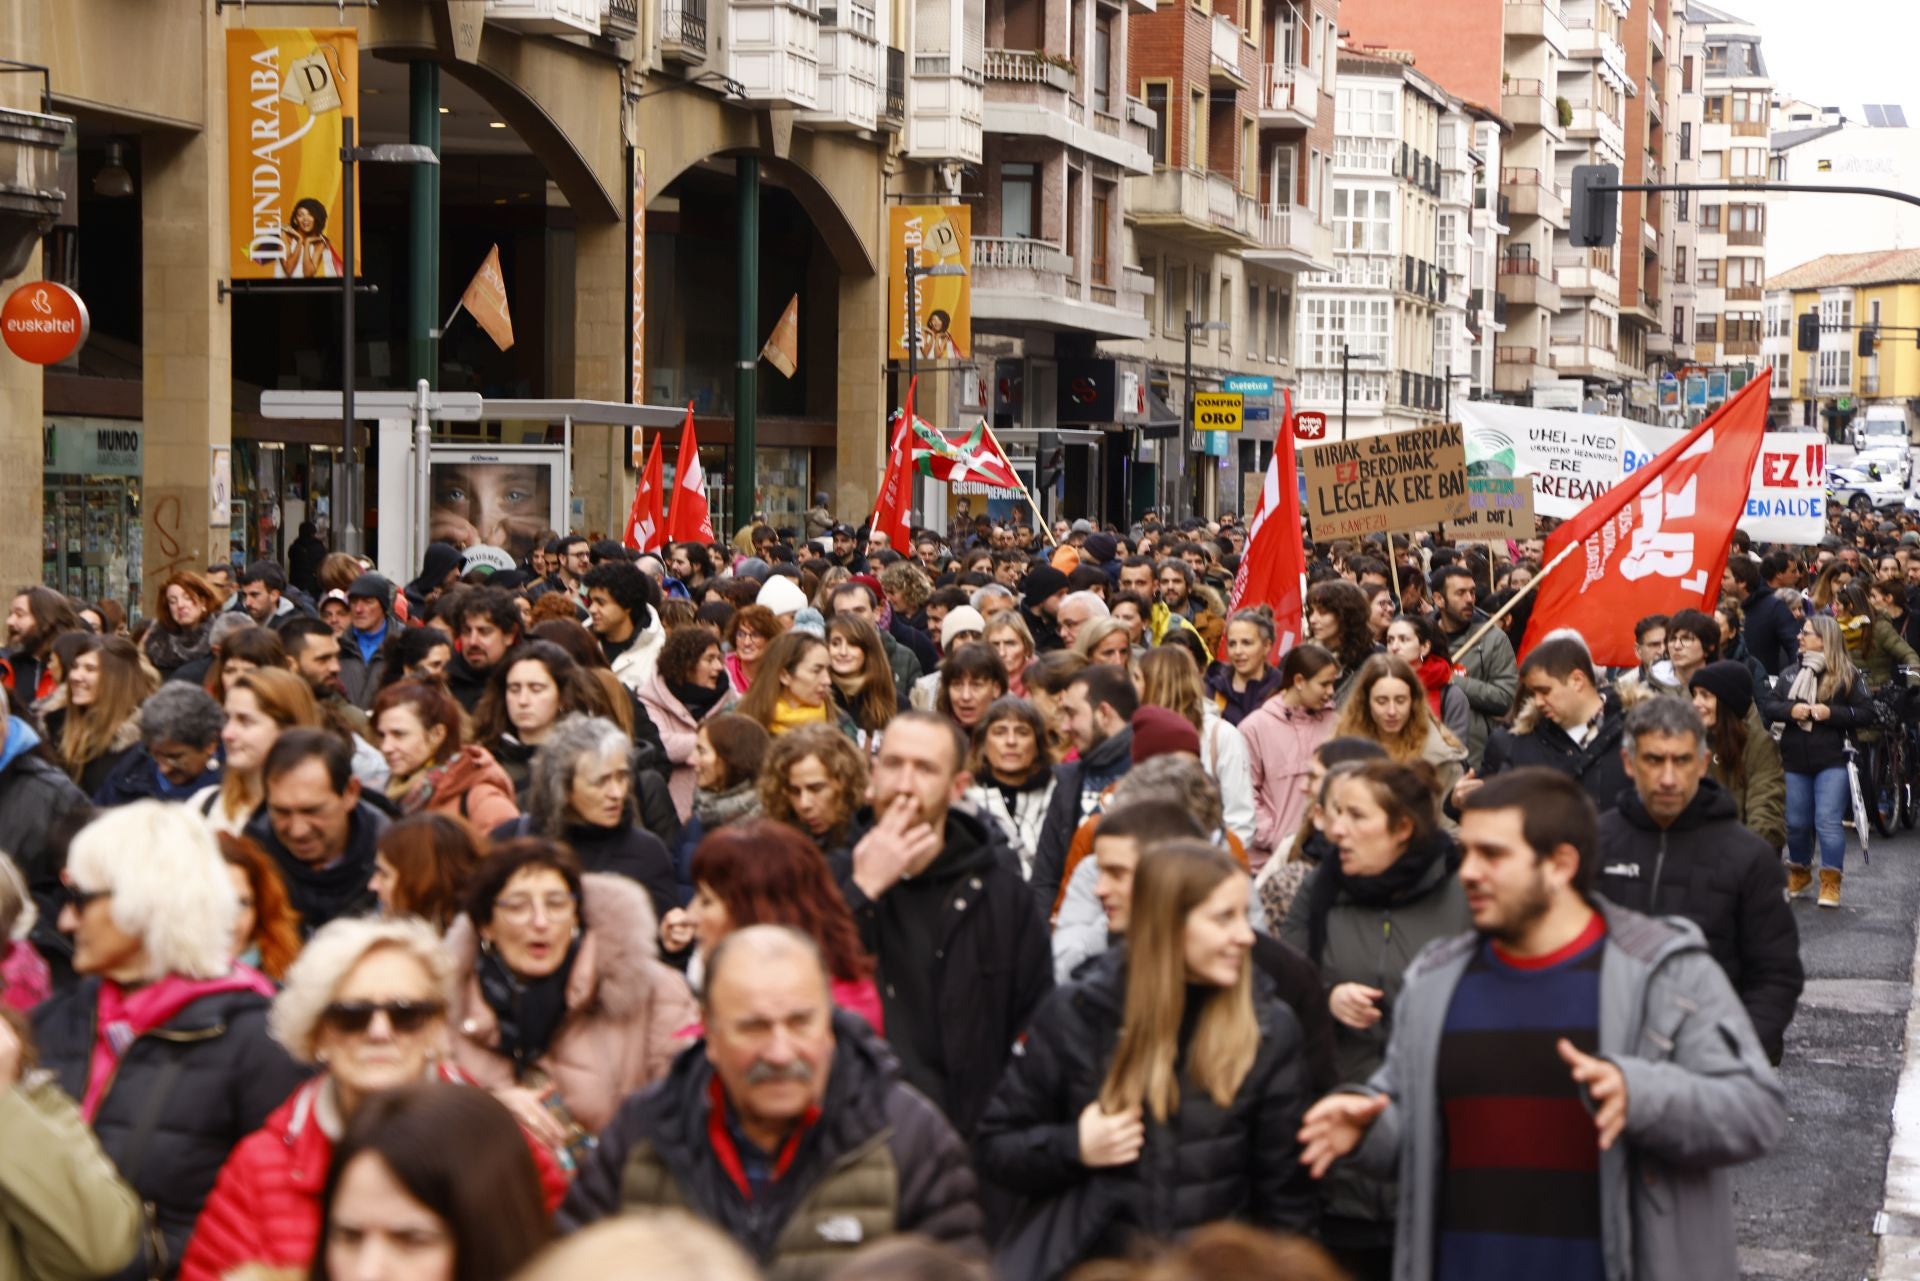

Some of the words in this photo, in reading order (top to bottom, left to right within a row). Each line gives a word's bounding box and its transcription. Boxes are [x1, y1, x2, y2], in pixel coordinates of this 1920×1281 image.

[250, 46, 287, 261] DENDARABA
[7, 318, 75, 333] euskaltel
[632, 208, 645, 452] DNDARABA
[1196, 398, 1241, 408] COMPRO
[1201, 412, 1236, 424] ORO
[97, 430, 138, 452] MUNDO
[1314, 442, 1361, 468] HIRIAK
[1396, 426, 1461, 454] HERRIAK
[1529, 428, 1566, 444] UHEI
[1582, 433, 1616, 450] IVED
[1335, 460, 1358, 482] EZ
[1549, 458, 1582, 473] ERE
[1318, 476, 1399, 517] LEGEAK
[1403, 474, 1434, 503] ERE
[1340, 514, 1387, 535] KANPEZU
